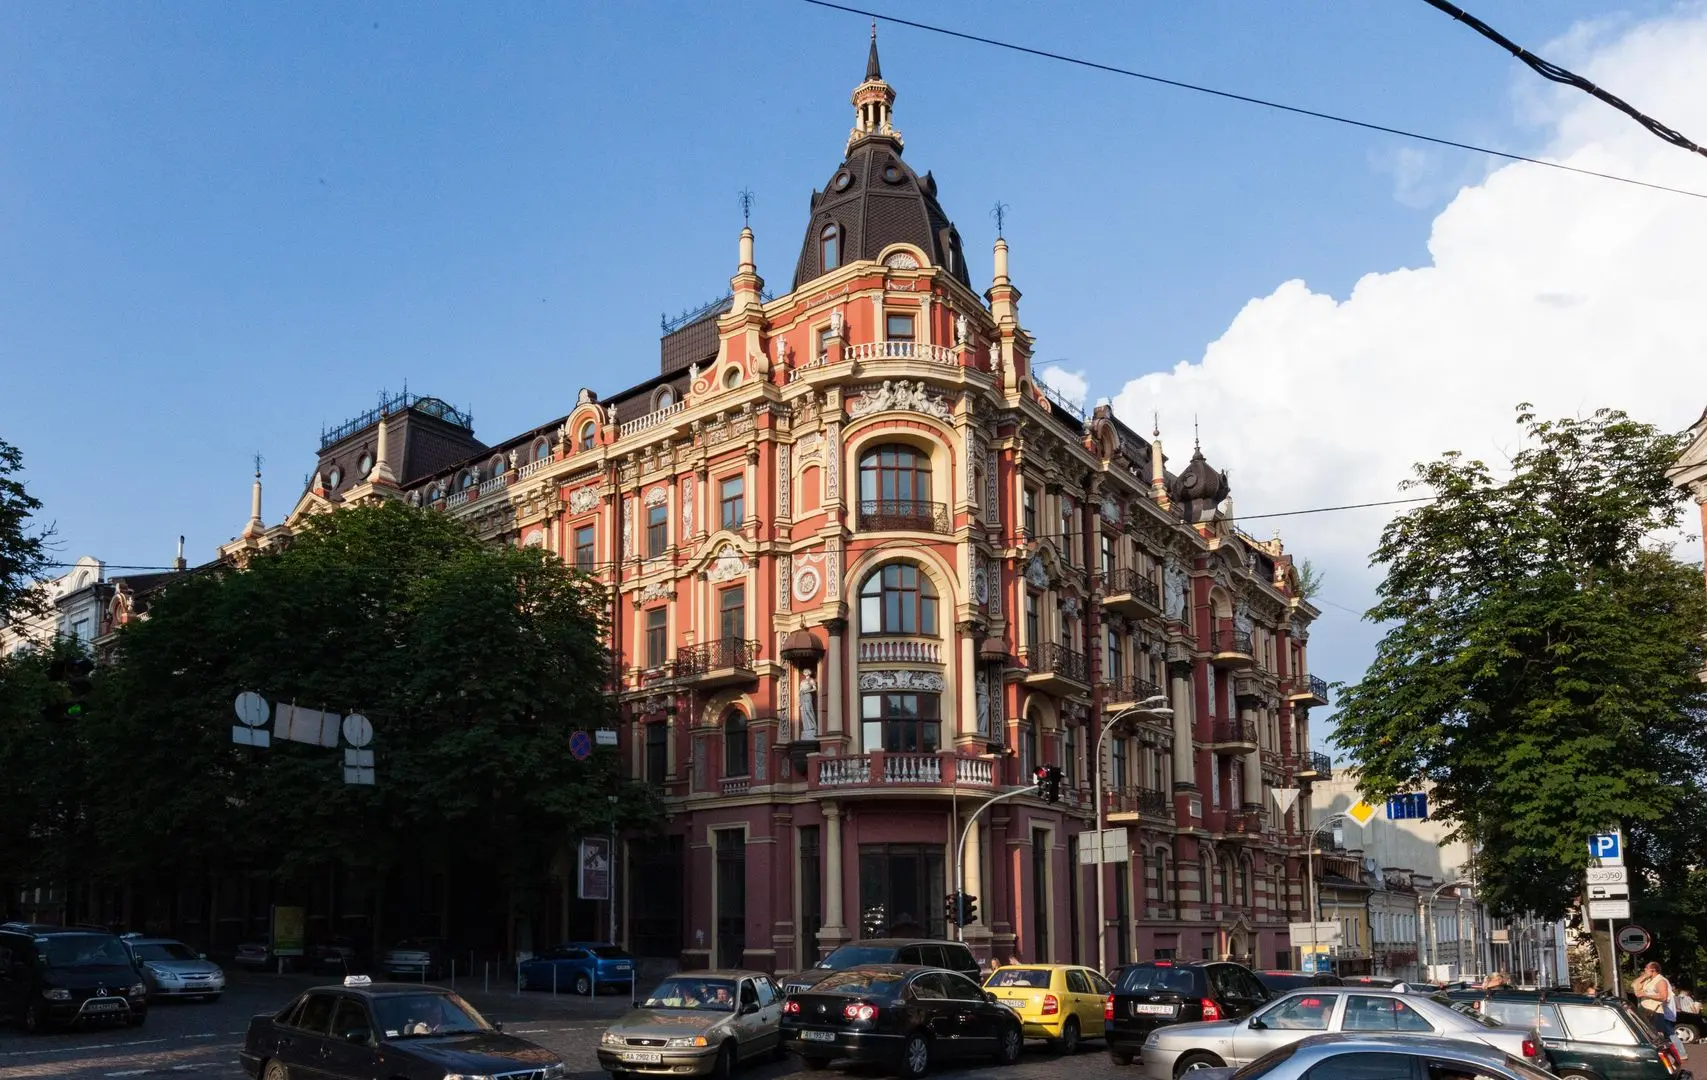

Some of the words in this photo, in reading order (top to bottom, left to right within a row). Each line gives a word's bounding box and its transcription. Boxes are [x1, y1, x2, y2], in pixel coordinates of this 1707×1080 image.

[1597, 836, 1614, 857] P
[1610, 871, 1620, 879] 50
[650, 1054, 660, 1062] EX
